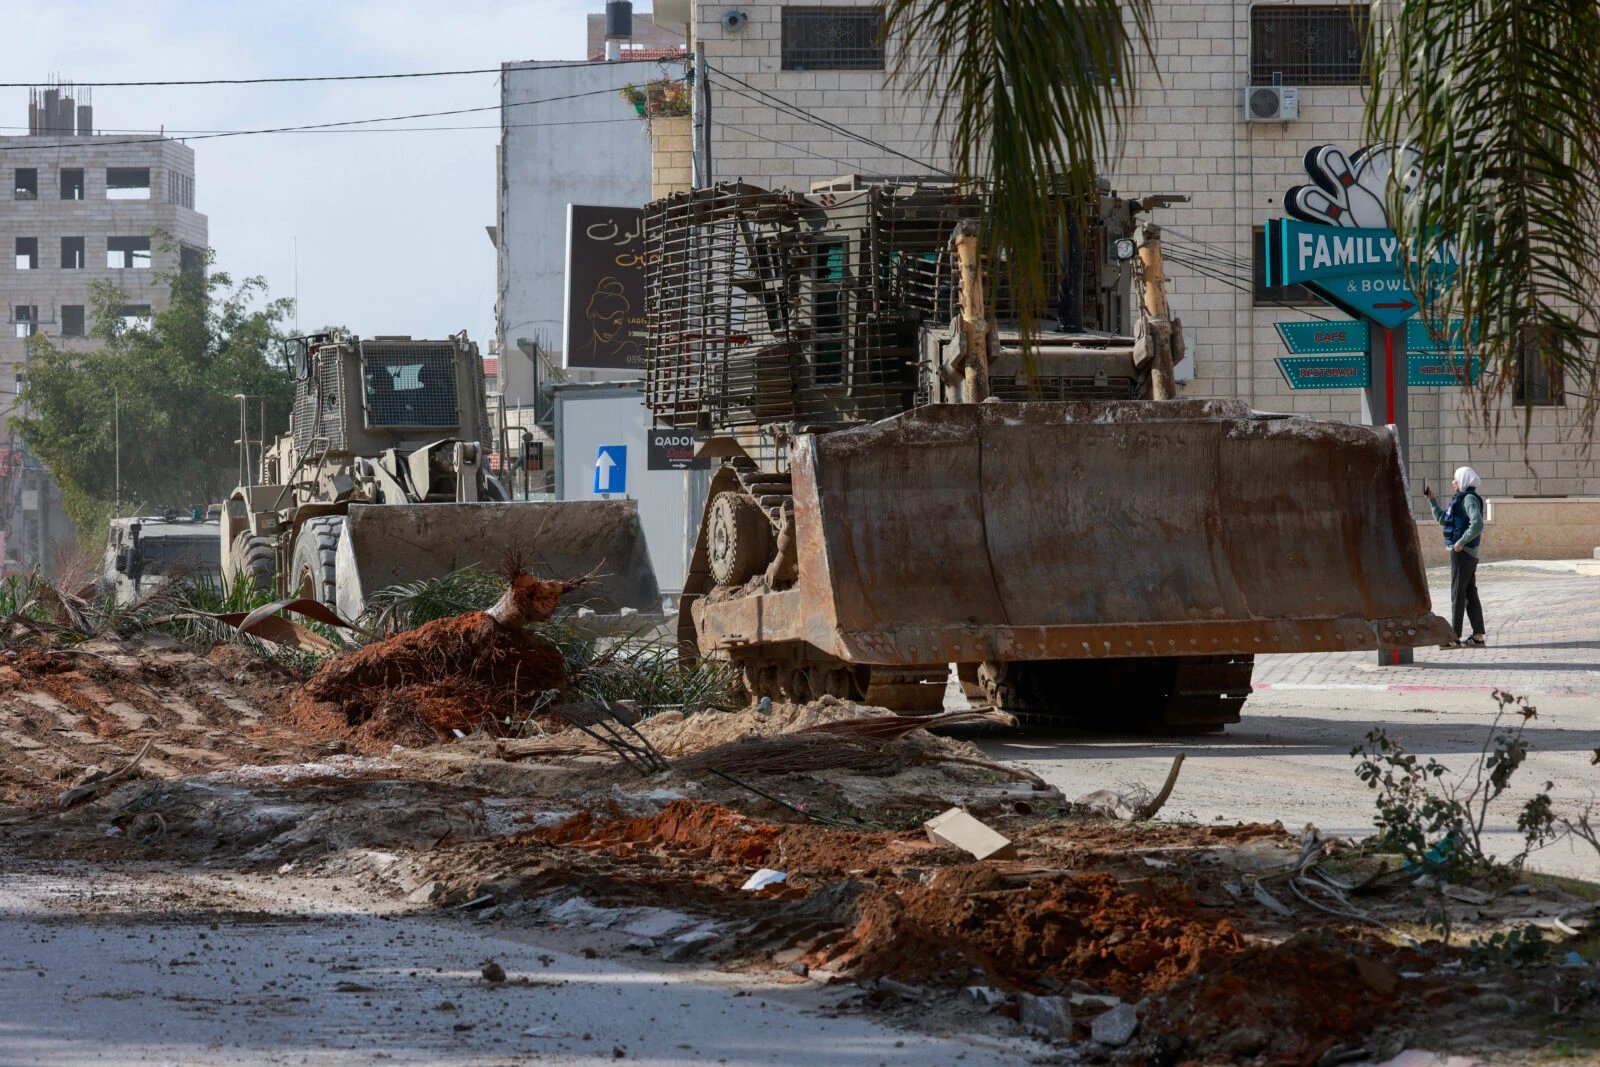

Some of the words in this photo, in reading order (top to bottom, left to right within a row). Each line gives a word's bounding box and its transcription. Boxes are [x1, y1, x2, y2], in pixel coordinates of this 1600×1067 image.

[1298, 232, 1397, 271] FAMILY
[1346, 280, 1358, 292] &
[1361, 279, 1442, 292] BOWLG
[1313, 331, 1347, 343] CAFE
[1299, 367, 1359, 378] RESTURANT
[1419, 365, 1442, 375] KIDS
